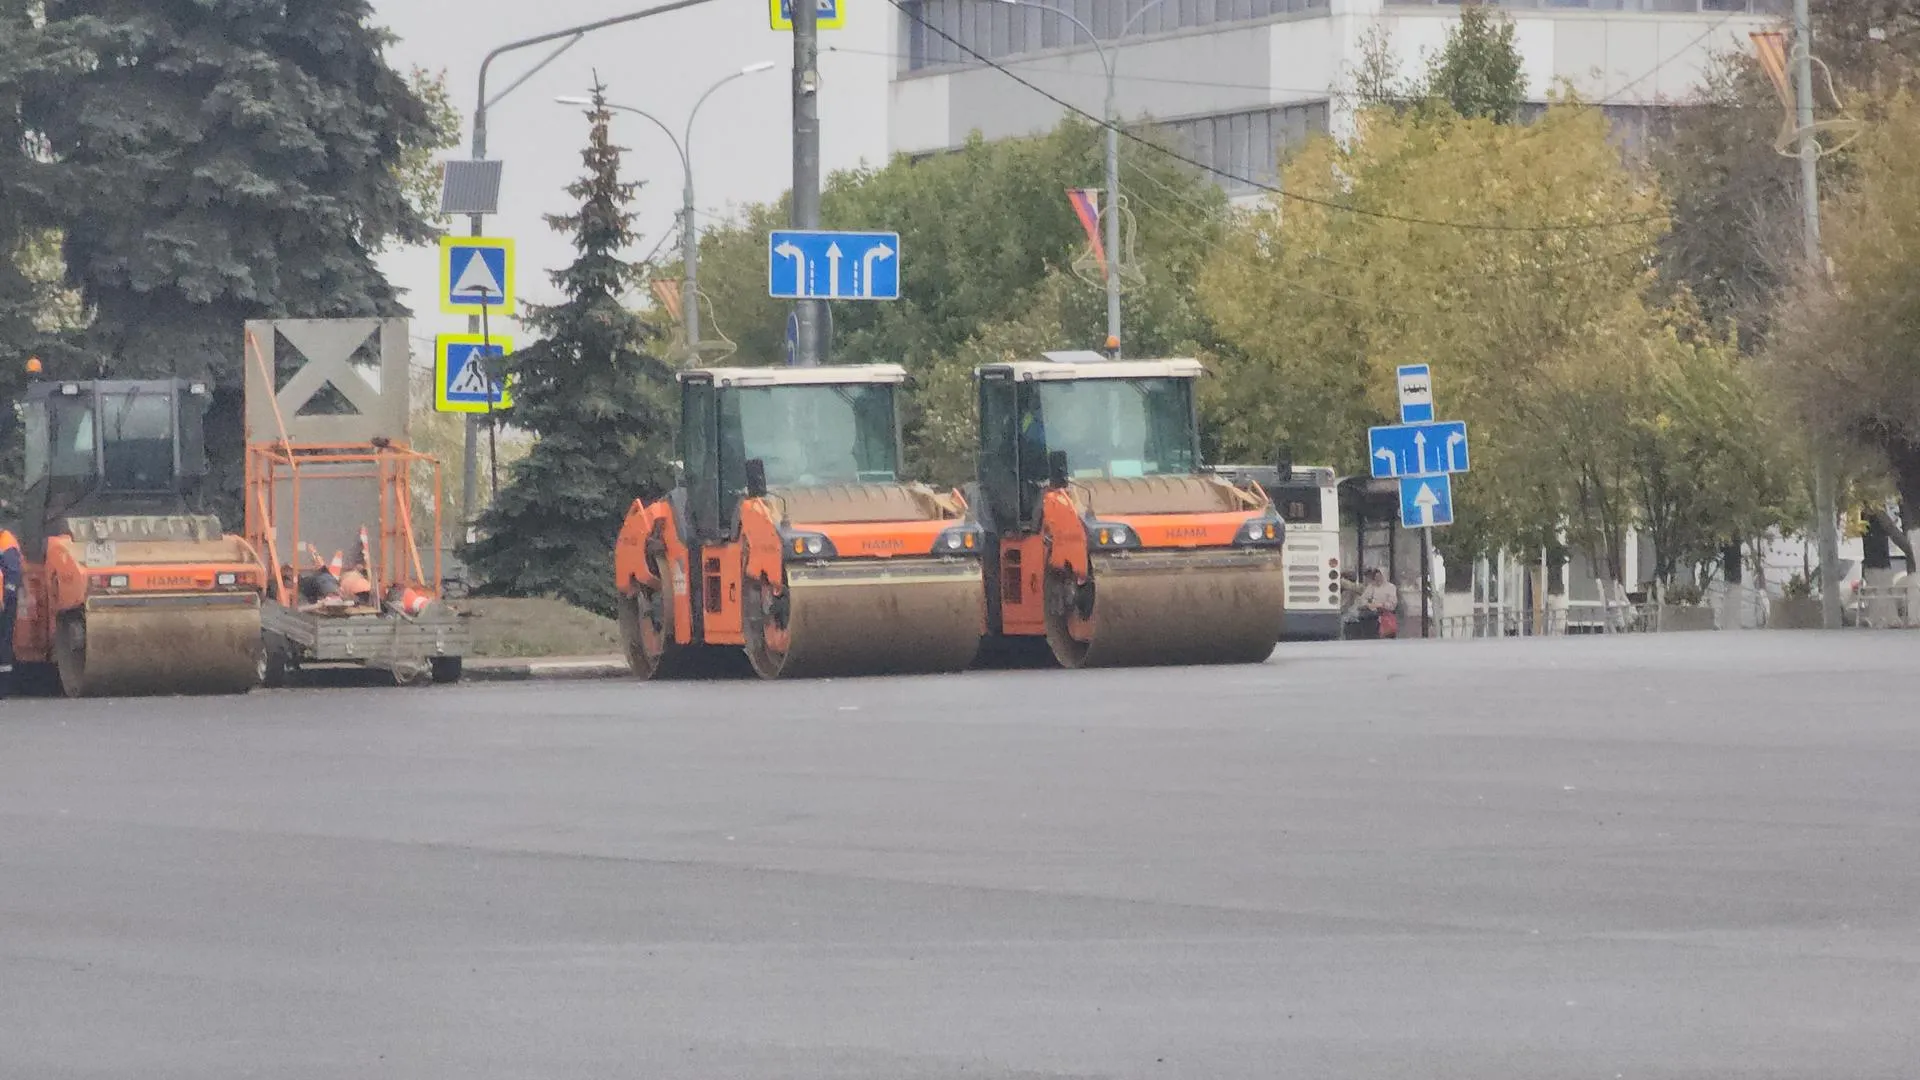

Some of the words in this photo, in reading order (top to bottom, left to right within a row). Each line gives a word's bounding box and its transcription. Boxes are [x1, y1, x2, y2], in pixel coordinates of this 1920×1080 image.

[1165, 527, 1207, 539] HAMM
[862, 539, 905, 550] HAMM
[146, 576, 191, 586] HAMM
